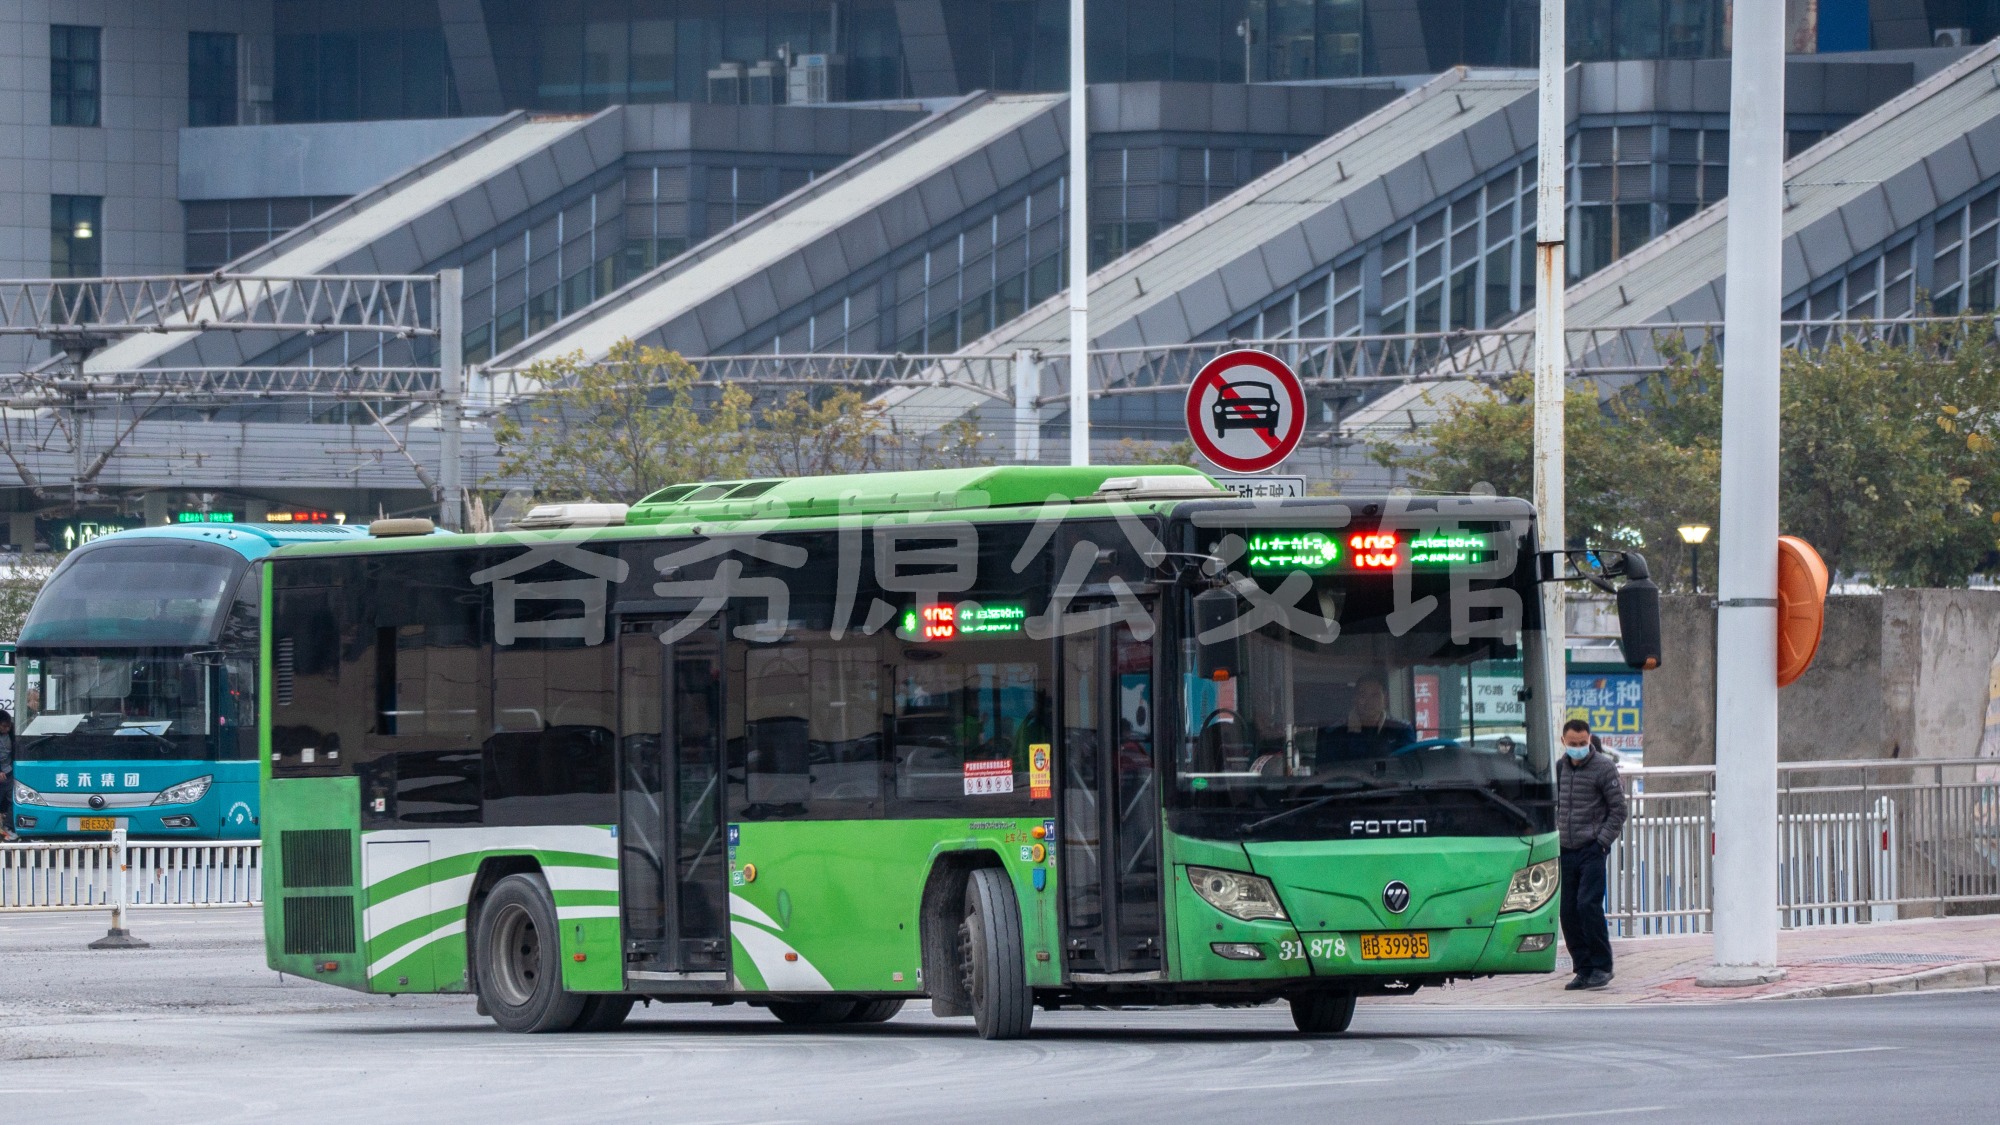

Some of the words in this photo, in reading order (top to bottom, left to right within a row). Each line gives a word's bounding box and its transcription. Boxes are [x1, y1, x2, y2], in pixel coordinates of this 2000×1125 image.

[56, 772, 140, 788] 泰禾集团
[1350, 818, 1428, 835] FOTON
